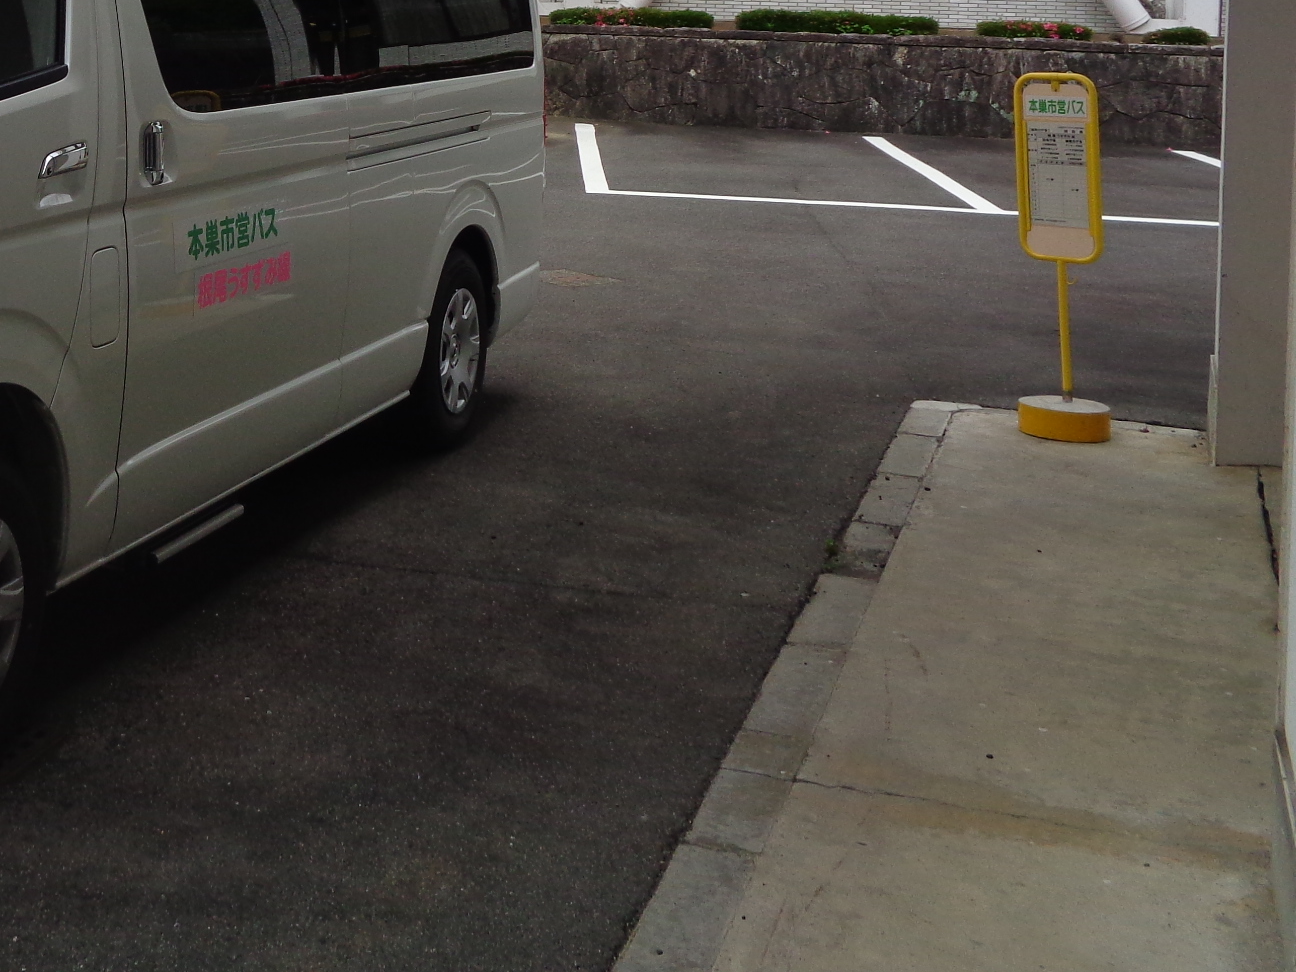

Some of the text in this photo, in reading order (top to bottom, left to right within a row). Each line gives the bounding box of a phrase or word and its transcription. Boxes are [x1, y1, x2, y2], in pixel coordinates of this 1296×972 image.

[1028, 98, 1086, 115] 本巣市営バス
[187, 207, 278, 261] 本巣市営バス
